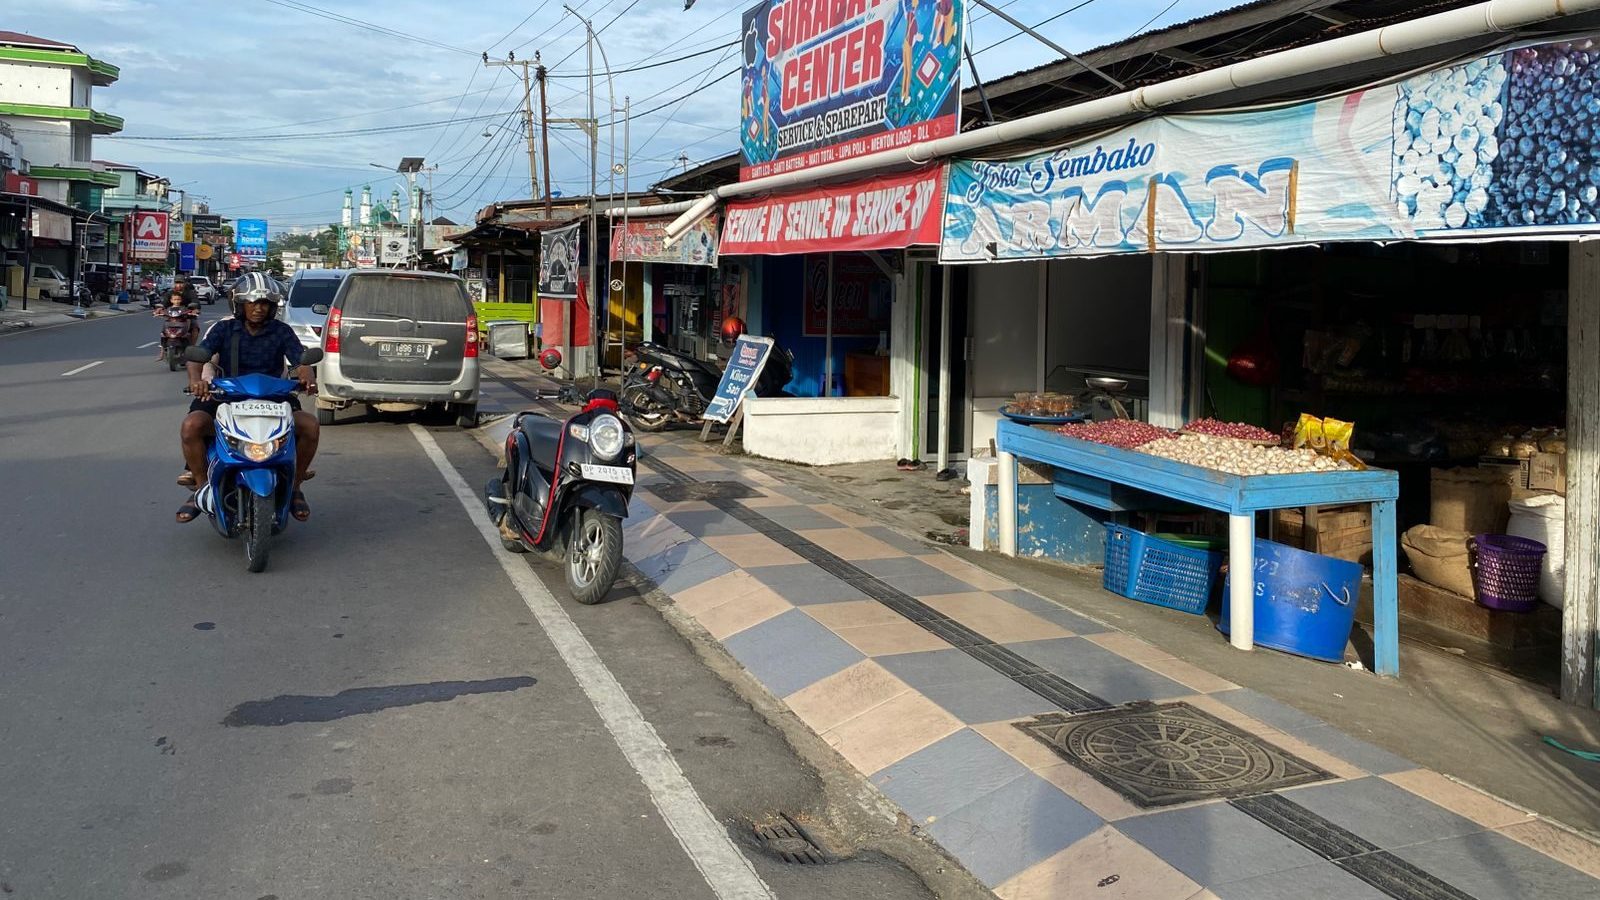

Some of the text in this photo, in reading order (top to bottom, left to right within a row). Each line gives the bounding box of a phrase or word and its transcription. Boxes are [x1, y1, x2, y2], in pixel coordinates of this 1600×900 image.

[766, 0, 882, 60] SURABA
[781, 18, 885, 113] CENTER
[777, 97, 887, 149] SERVICE & SPAREPART
[820, 149, 835, 164] TOTAL
[839, 144, 851, 159] LUPA
[852, 141, 866, 155] POLA
[871, 133, 895, 151] MENTOK
[895, 128, 912, 146] LOGO
[917, 124, 930, 141] DLL
[966, 138, 1156, 202] Toko Sembako
[724, 206, 768, 243] SERVICE
[767, 204, 784, 242] HP
[785, 197, 833, 241] SERVICE
[831, 195, 851, 238] HP
[852, 185, 911, 237] SERVICE
[960, 157, 1296, 255] ARMAN
[381, 344, 391, 352] KU
